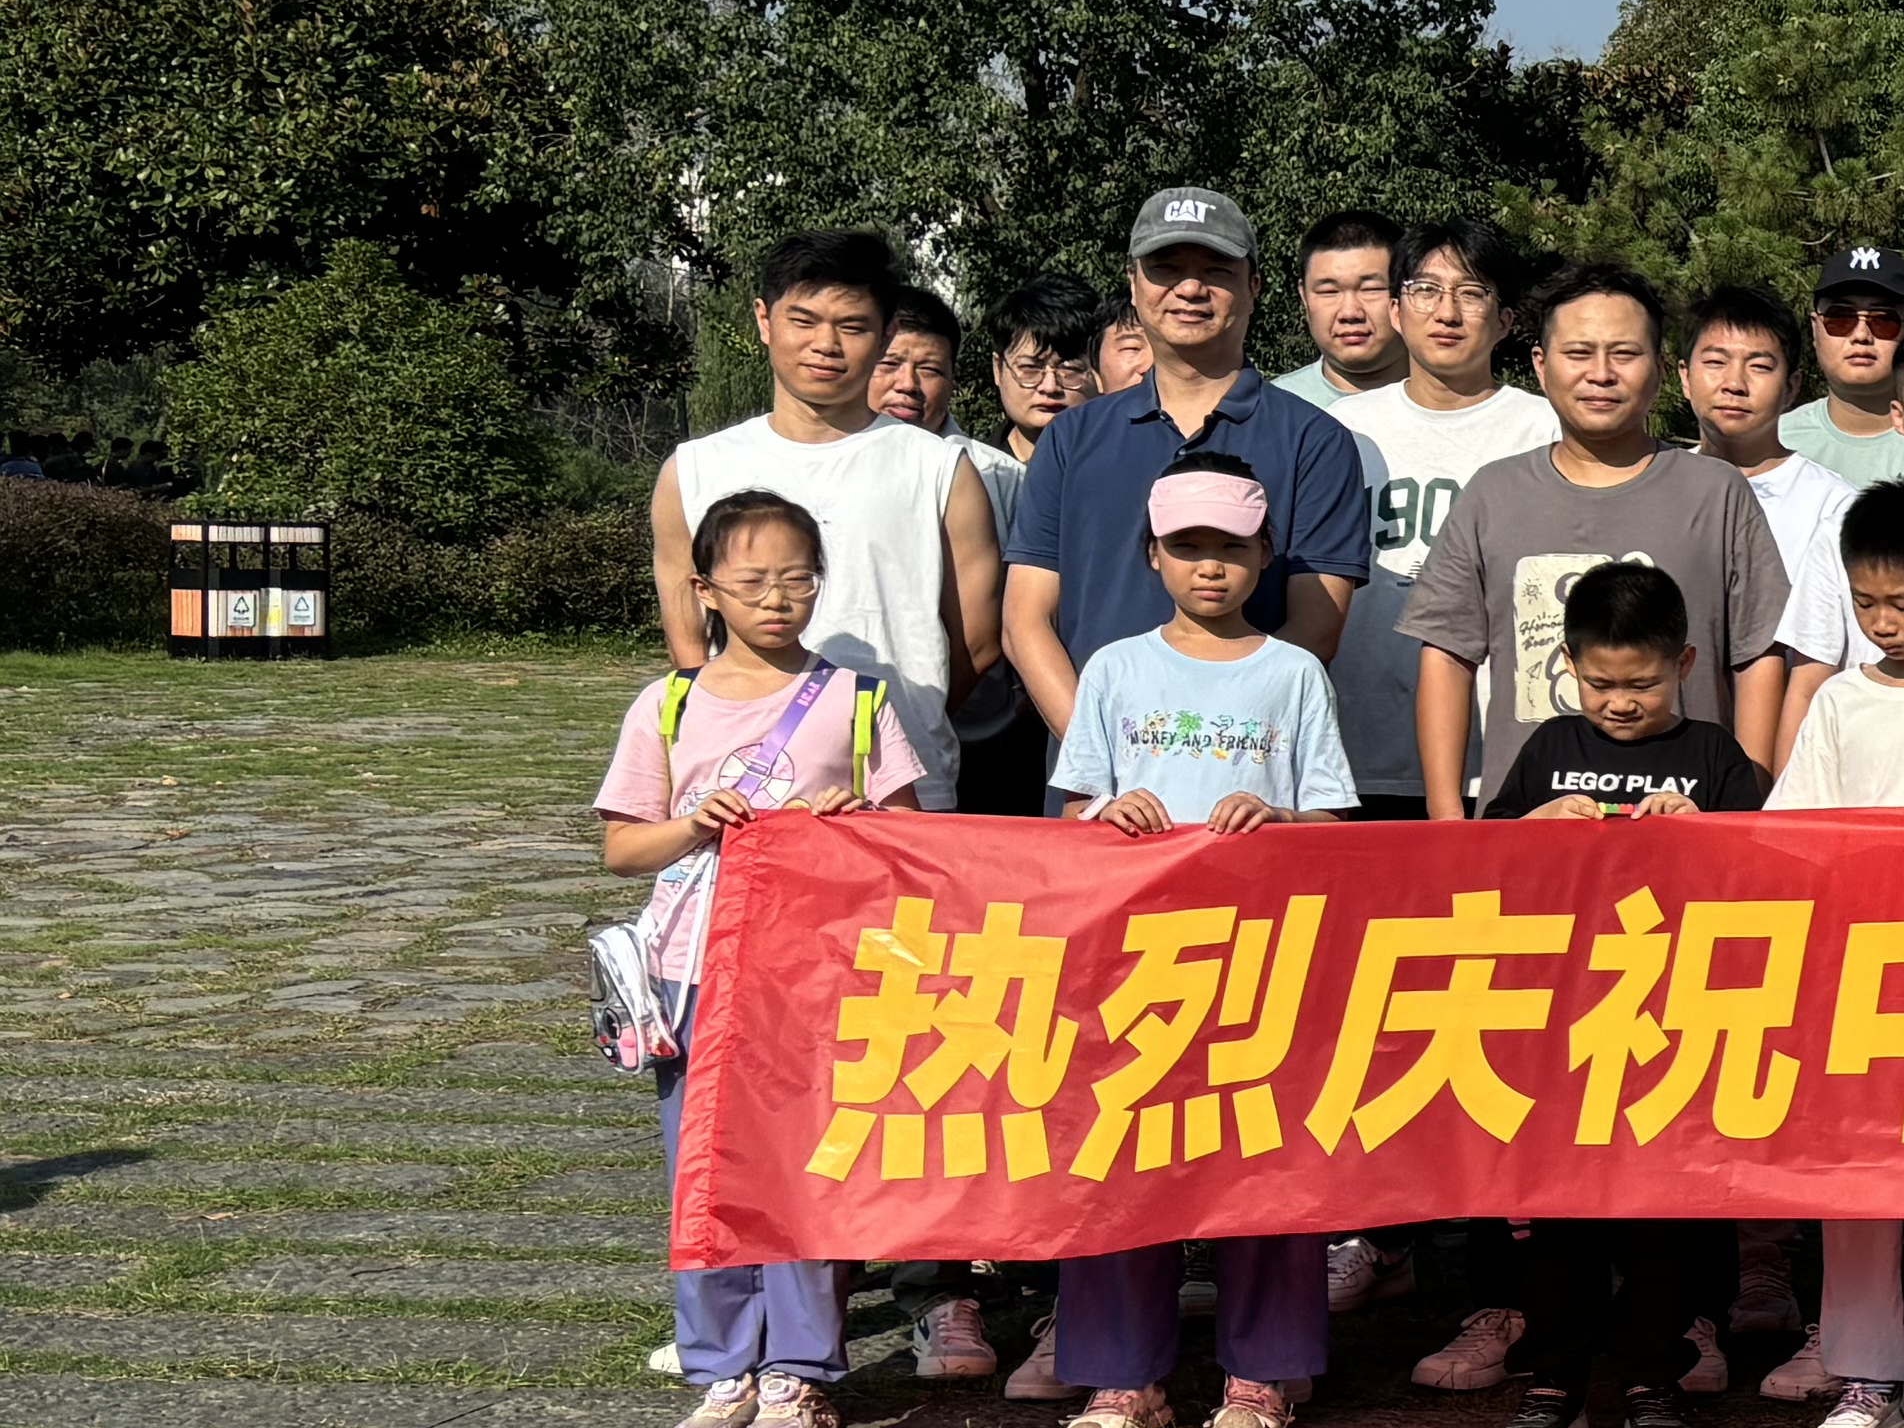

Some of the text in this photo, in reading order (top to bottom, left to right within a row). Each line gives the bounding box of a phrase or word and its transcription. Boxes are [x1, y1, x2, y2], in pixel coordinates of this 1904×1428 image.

[1164, 199, 1209, 223] CAT
[1364, 477, 1463, 551] 90
[1551, 771, 1698, 796] LEGO PLAY
